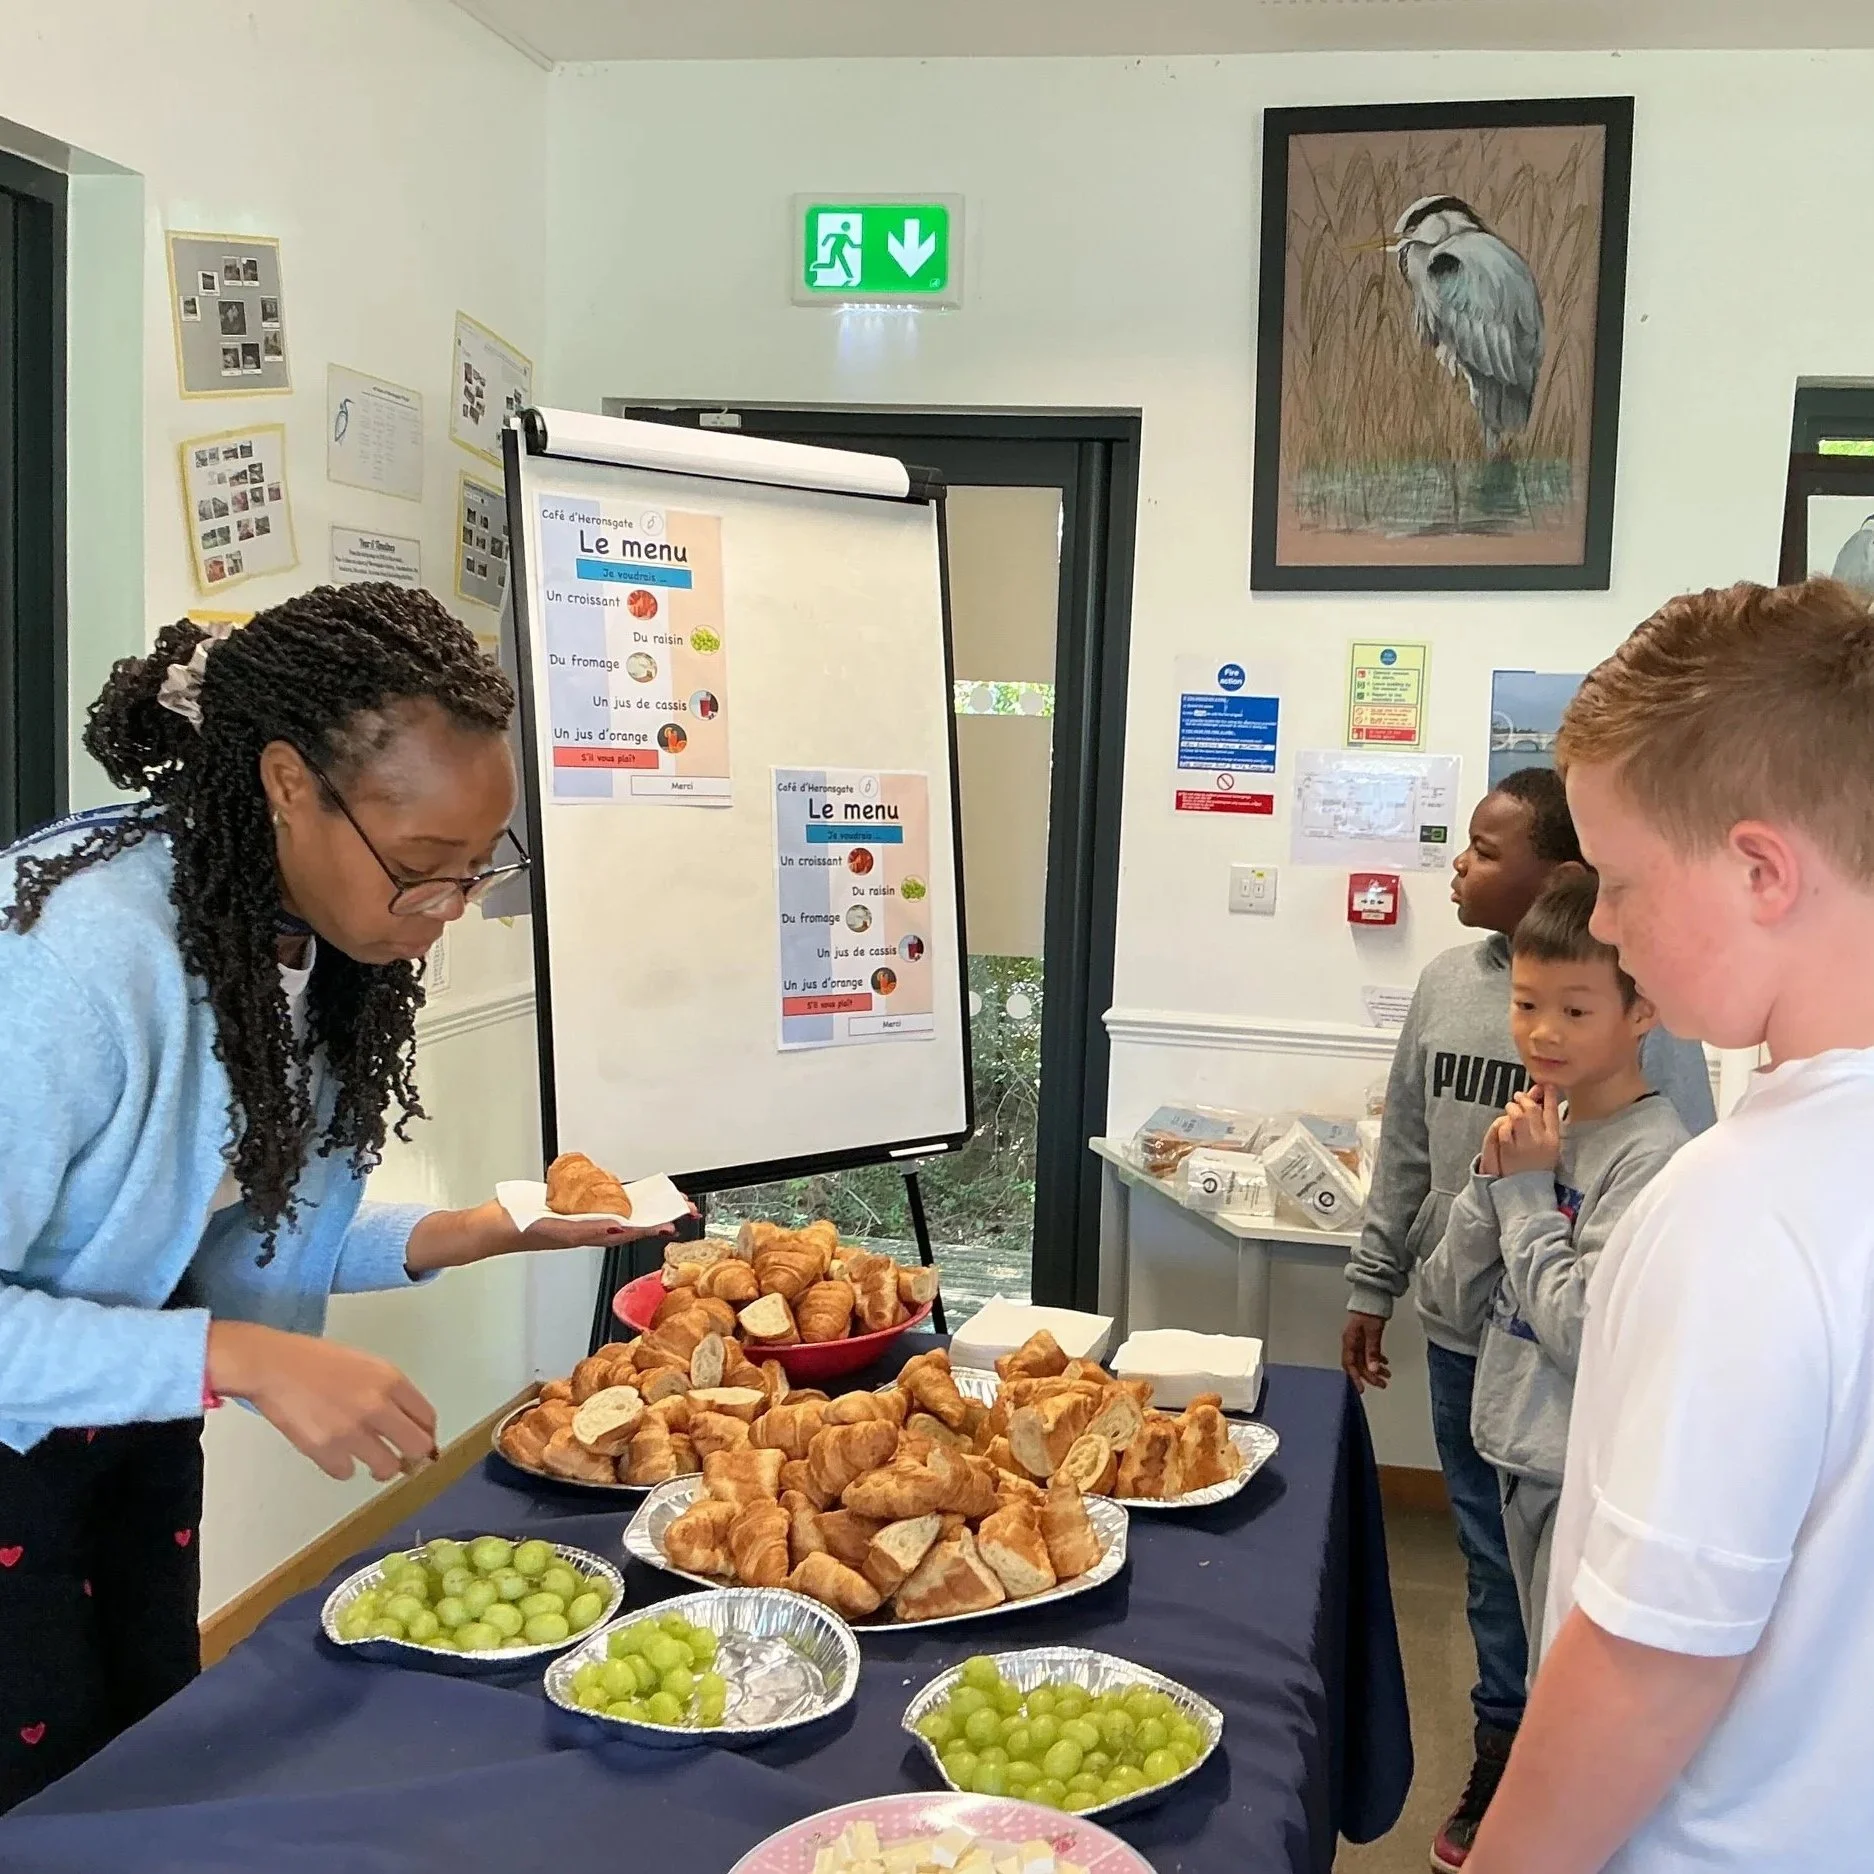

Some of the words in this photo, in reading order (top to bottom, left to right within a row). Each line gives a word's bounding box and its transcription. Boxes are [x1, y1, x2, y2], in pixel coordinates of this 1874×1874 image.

[542, 510, 565, 522] Café
[569, 512, 633, 530] d'Heronsgate
[579, 530, 609, 555] Le
[622, 539, 687, 563] menu
[603, 568, 614, 579] Je
[617, 570, 656, 583] voudrais
[547, 590, 562, 600] Un
[568, 593, 620, 607] croissant
[633, 632, 649, 643] Du
[653, 633, 683, 645] raisin
[550, 654, 566, 666] Du
[571, 655, 619, 670] fromage
[1224, 668, 1239, 676] Fire
[593, 696, 608, 708] Un
[614, 698, 632, 710] jus
[637, 697, 650, 709] de
[656, 699, 687, 712] cassis
[554, 728, 569, 740] Un
[574, 729, 593, 742] jus
[598, 728, 648, 744] d'orange
[672, 781, 693, 790] Merci
[777, 783, 796, 792] Café
[800, 783, 854, 796] d'Heronsgate
[809, 798, 833, 819] Le
[844, 802, 899, 820] menu
[781, 857, 795, 866] Un
[799, 856, 842, 866] croissant
[853, 886, 864, 896] Du
[869, 886, 895, 896] raisin
[782, 913, 795, 923] Du
[800, 912, 840, 925] fromage
[817, 949, 830, 958] Un
[834, 949, 849, 959] jus
[853, 948, 865, 957] de
[870, 947, 897, 956] cassis
[784, 980, 798, 990] Un
[802, 980, 817, 992] jus
[822, 976, 863, 990] d'orange
[1433, 1052, 1537, 1109] PUM
